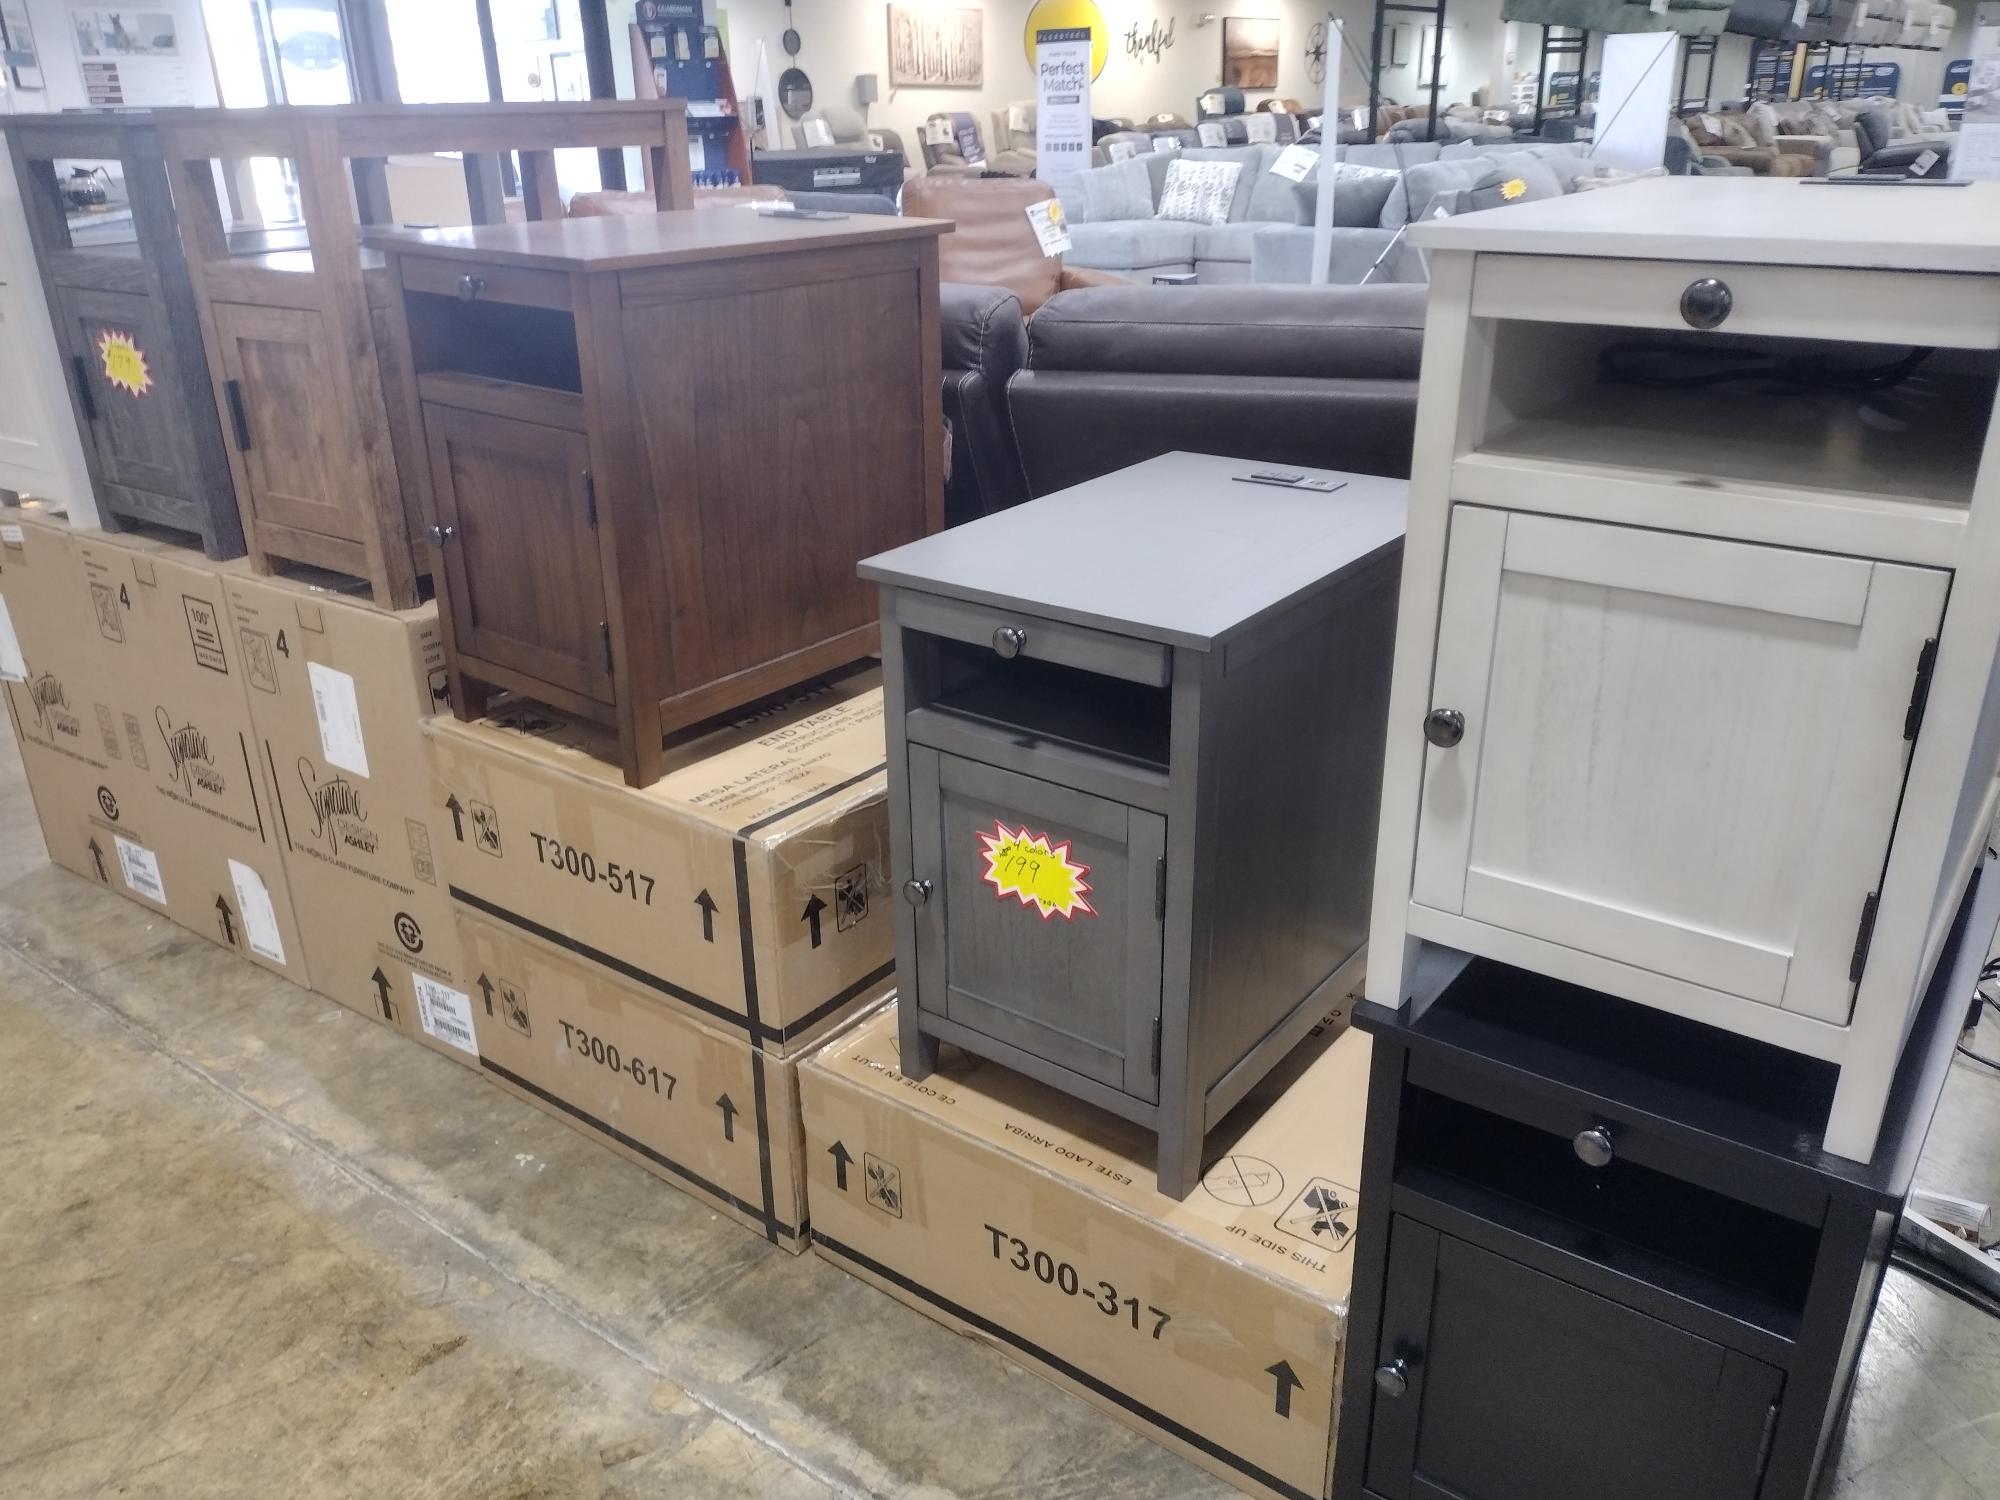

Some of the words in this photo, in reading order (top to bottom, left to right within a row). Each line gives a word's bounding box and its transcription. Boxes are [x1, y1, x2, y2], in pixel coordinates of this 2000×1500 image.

[1125, 16, 1175, 64] thankful
[1040, 60, 1085, 77] Perfect
[119, 583, 131, 610] 4
[276, 629, 290, 659] 4
[757, 728, 798, 747] END
[795, 704, 854, 731] TABLE
[155, 704, 215, 798] Signature
[197, 778, 222, 795] ASHLEY
[688, 783, 735, 804] MESA
[732, 755, 802, 786] LATERAL
[297, 756, 368, 857] Signature
[344, 834, 374, 855] ASHLEY
[529, 831, 655, 905] T300-517
[1004, 856, 1041, 884] 199
[558, 1018, 677, 1101] T300-617
[936, 1094, 956, 1106] CE
[1004, 1121, 1055, 1148] ARRIBA
[1055, 1145, 1094, 1168] LADO
[1097, 1164, 1133, 1186] ESTE
[1225, 1224, 1249, 1237] UP
[1250, 1234, 1292, 1255] SIDE
[1291, 1251, 1328, 1273] THIS
[984, 1223, 1172, 1340] T300-317
